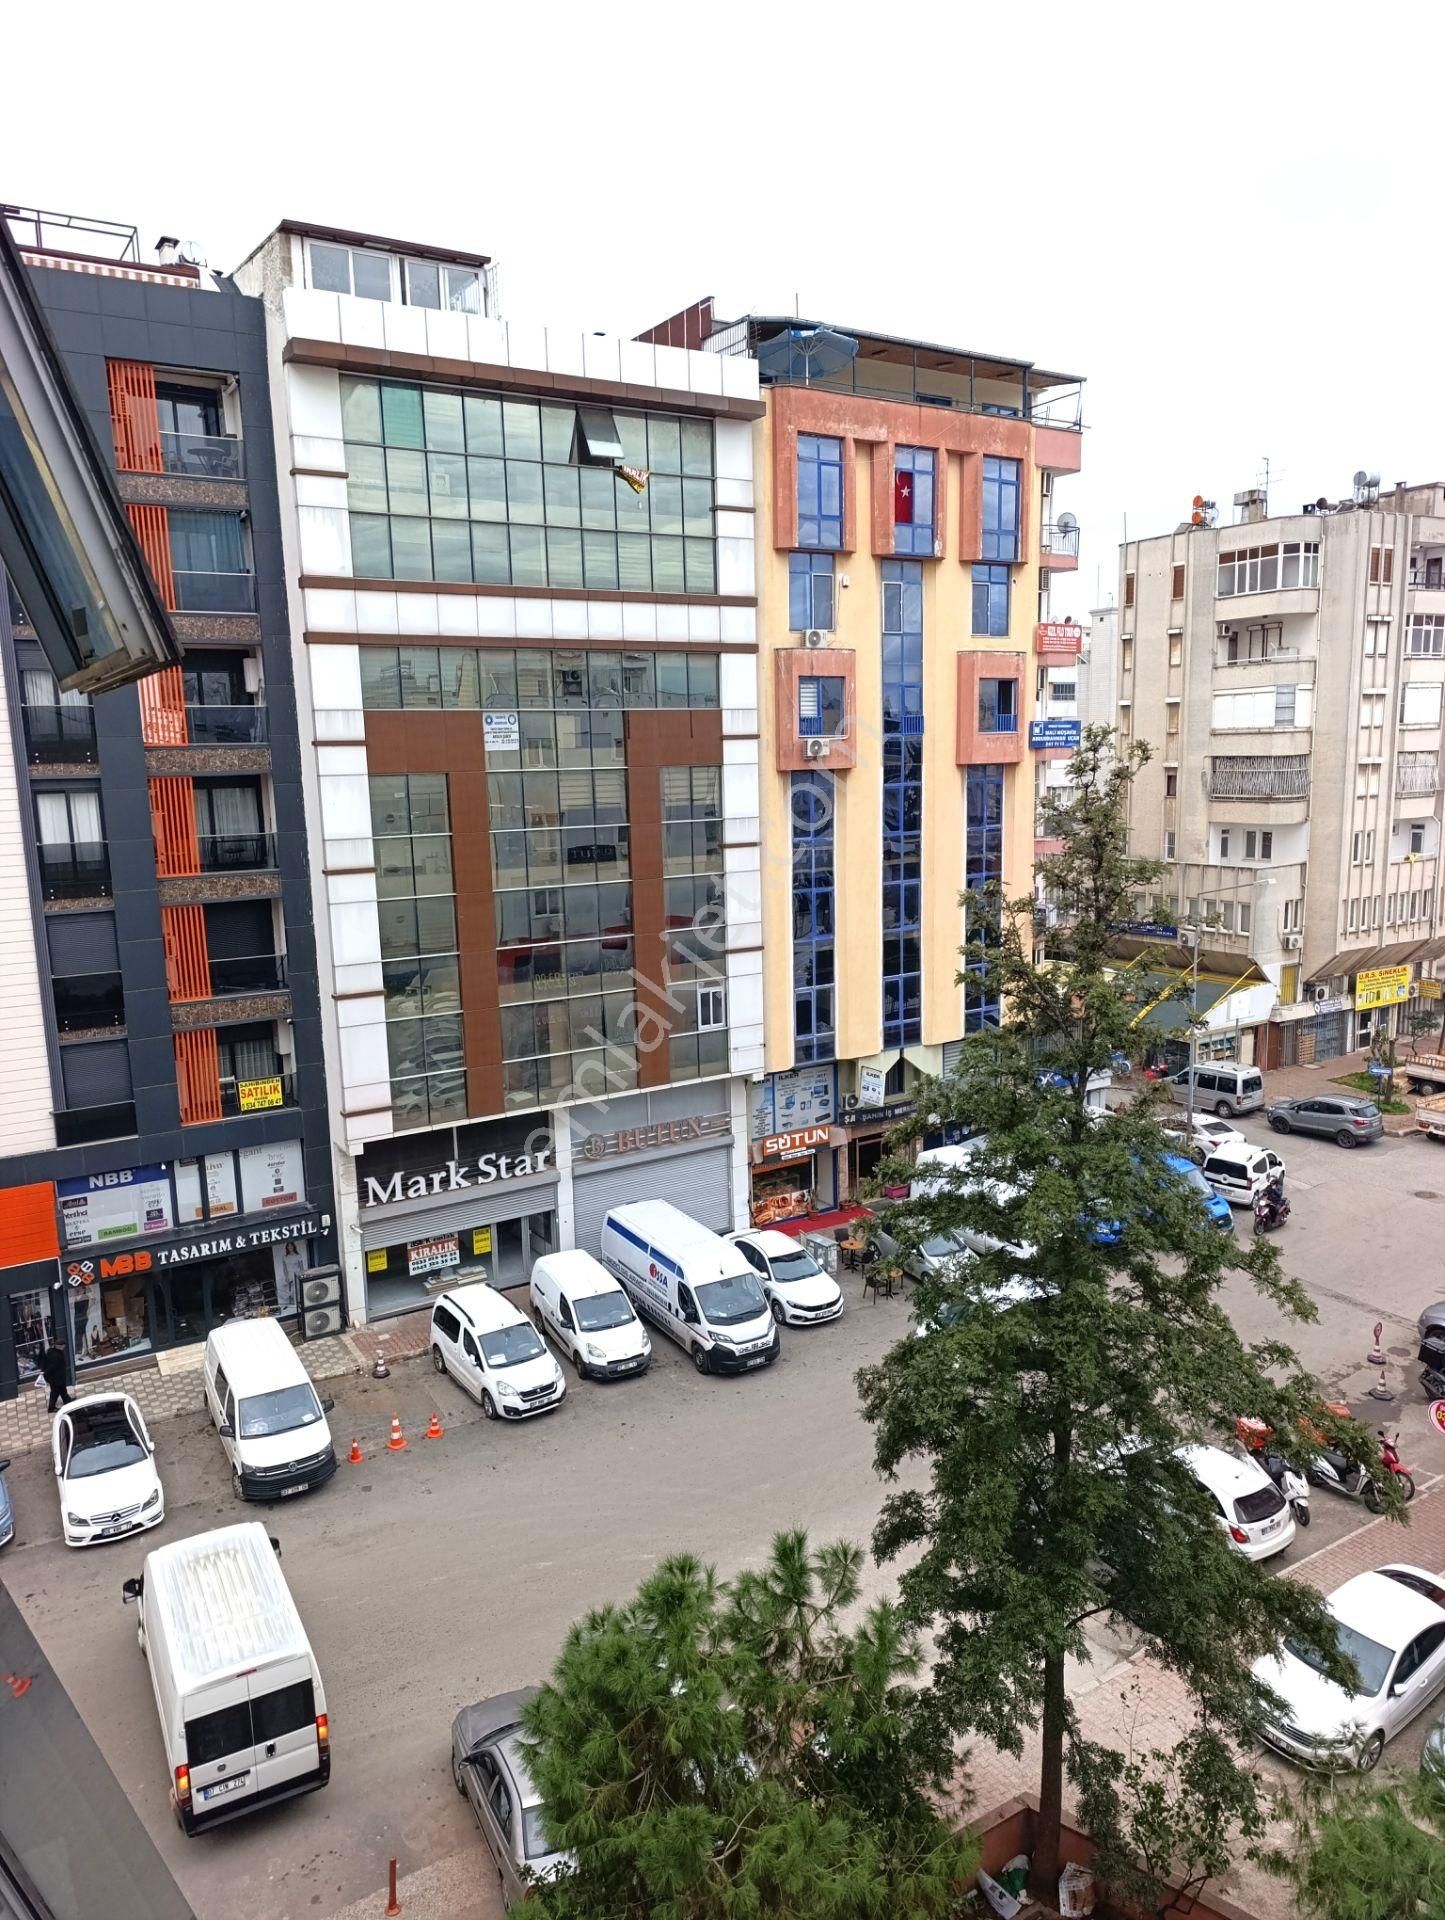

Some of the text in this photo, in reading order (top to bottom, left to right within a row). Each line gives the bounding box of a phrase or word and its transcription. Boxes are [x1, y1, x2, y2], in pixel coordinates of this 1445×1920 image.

[240, 1083, 280, 1099] SATILIK
[88, 1169, 134, 1189] NBB
[363, 1150, 551, 1208] Mark Star
[157, 1234, 232, 1266] TASARIM
[236, 1231, 247, 1250] &
[248, 1219, 317, 1246] TEKSTİL
[411, 1240, 457, 1261] KİRALIK
